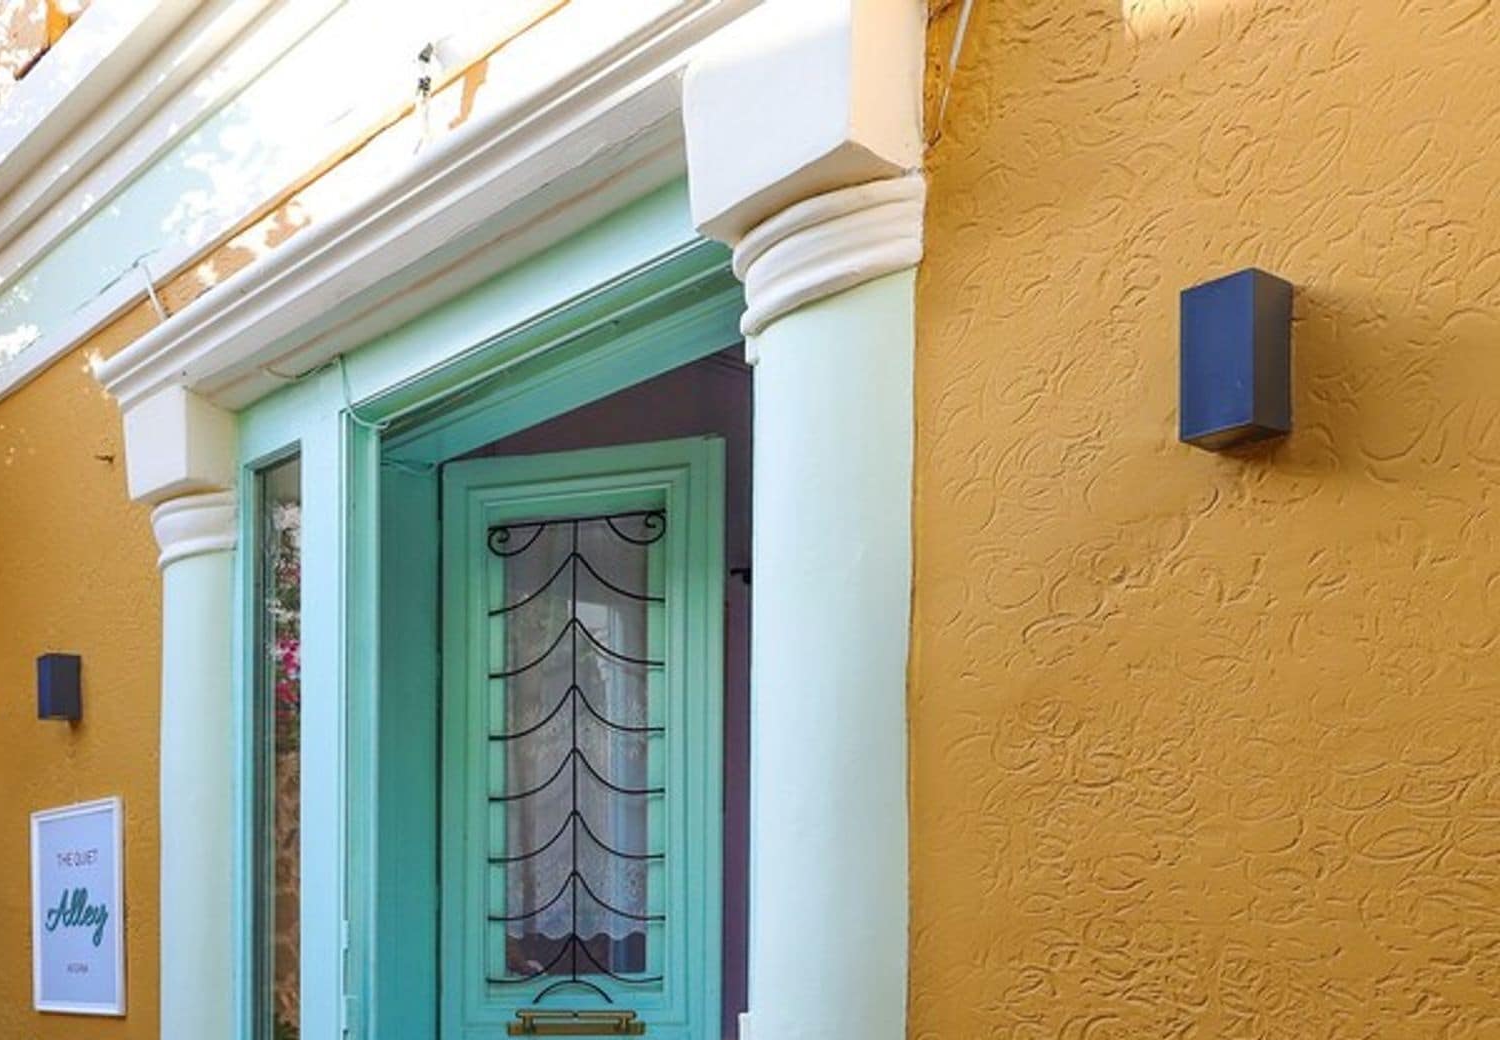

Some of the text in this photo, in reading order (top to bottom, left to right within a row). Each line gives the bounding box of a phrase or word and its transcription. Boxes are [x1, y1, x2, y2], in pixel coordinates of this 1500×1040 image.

[56, 848, 98, 868] THE QUIET
[45, 887, 108, 947] Alley
